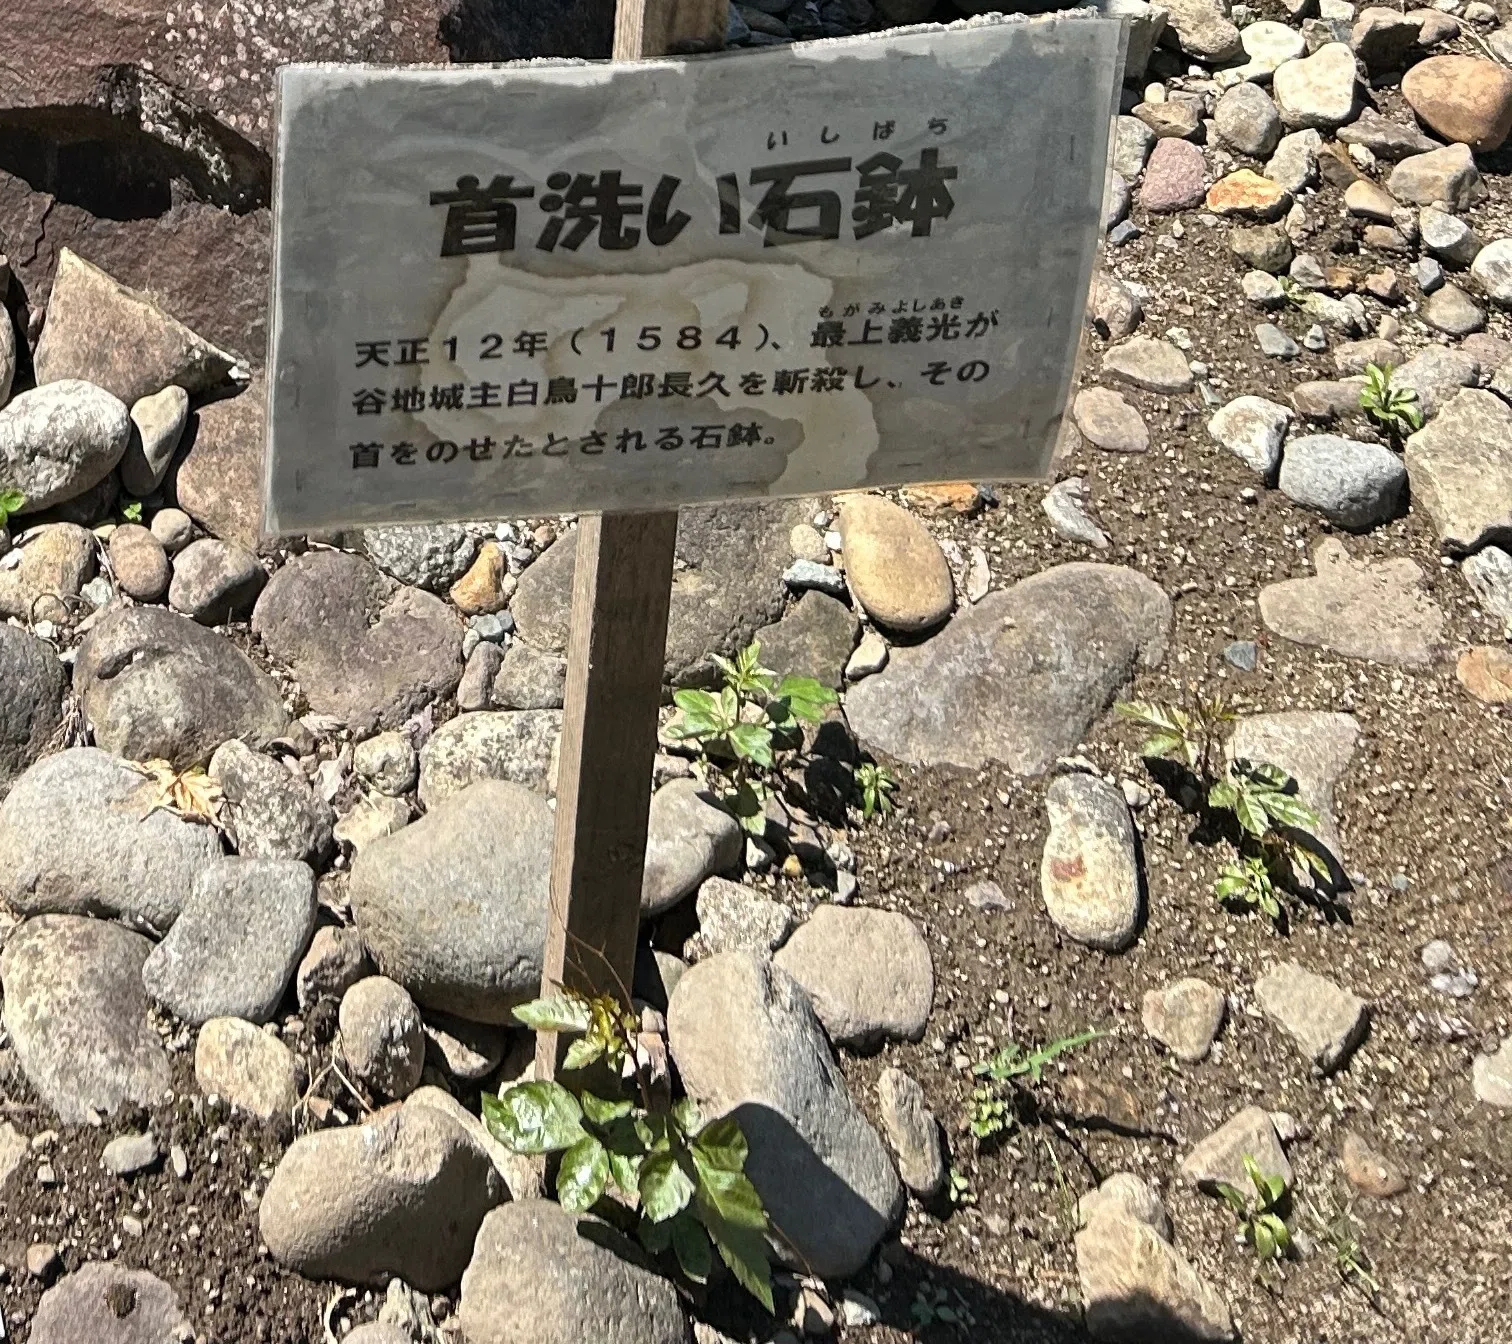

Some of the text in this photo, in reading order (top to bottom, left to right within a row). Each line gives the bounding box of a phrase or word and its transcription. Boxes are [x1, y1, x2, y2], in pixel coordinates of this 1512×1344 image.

[767, 117, 948, 150] いしばち
[429, 146, 958, 257] 首洗い石鉢
[349, 421, 775, 470] 首をのせたとされる石鉢。
